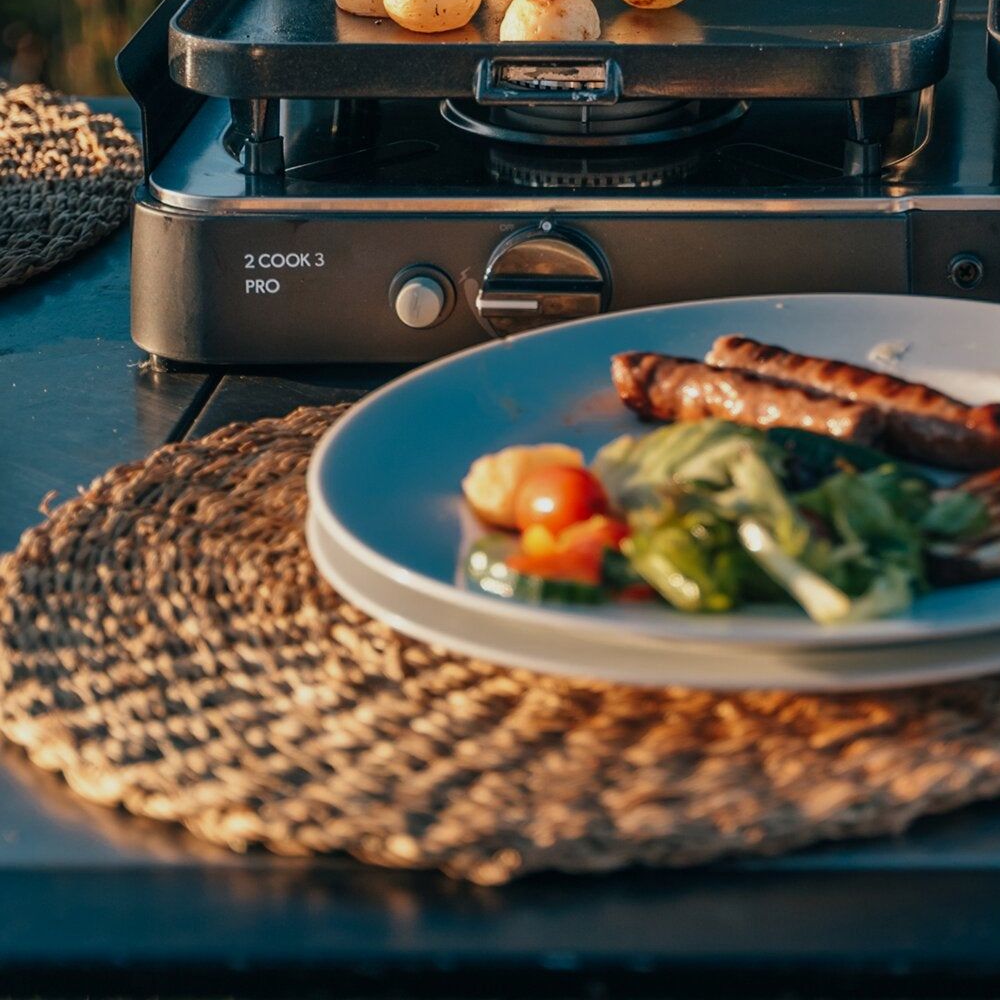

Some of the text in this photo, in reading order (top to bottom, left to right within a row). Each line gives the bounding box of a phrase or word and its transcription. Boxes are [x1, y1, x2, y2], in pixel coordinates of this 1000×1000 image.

[244, 252, 325, 268] 2 COOK 3
[245, 279, 280, 294] PRO
